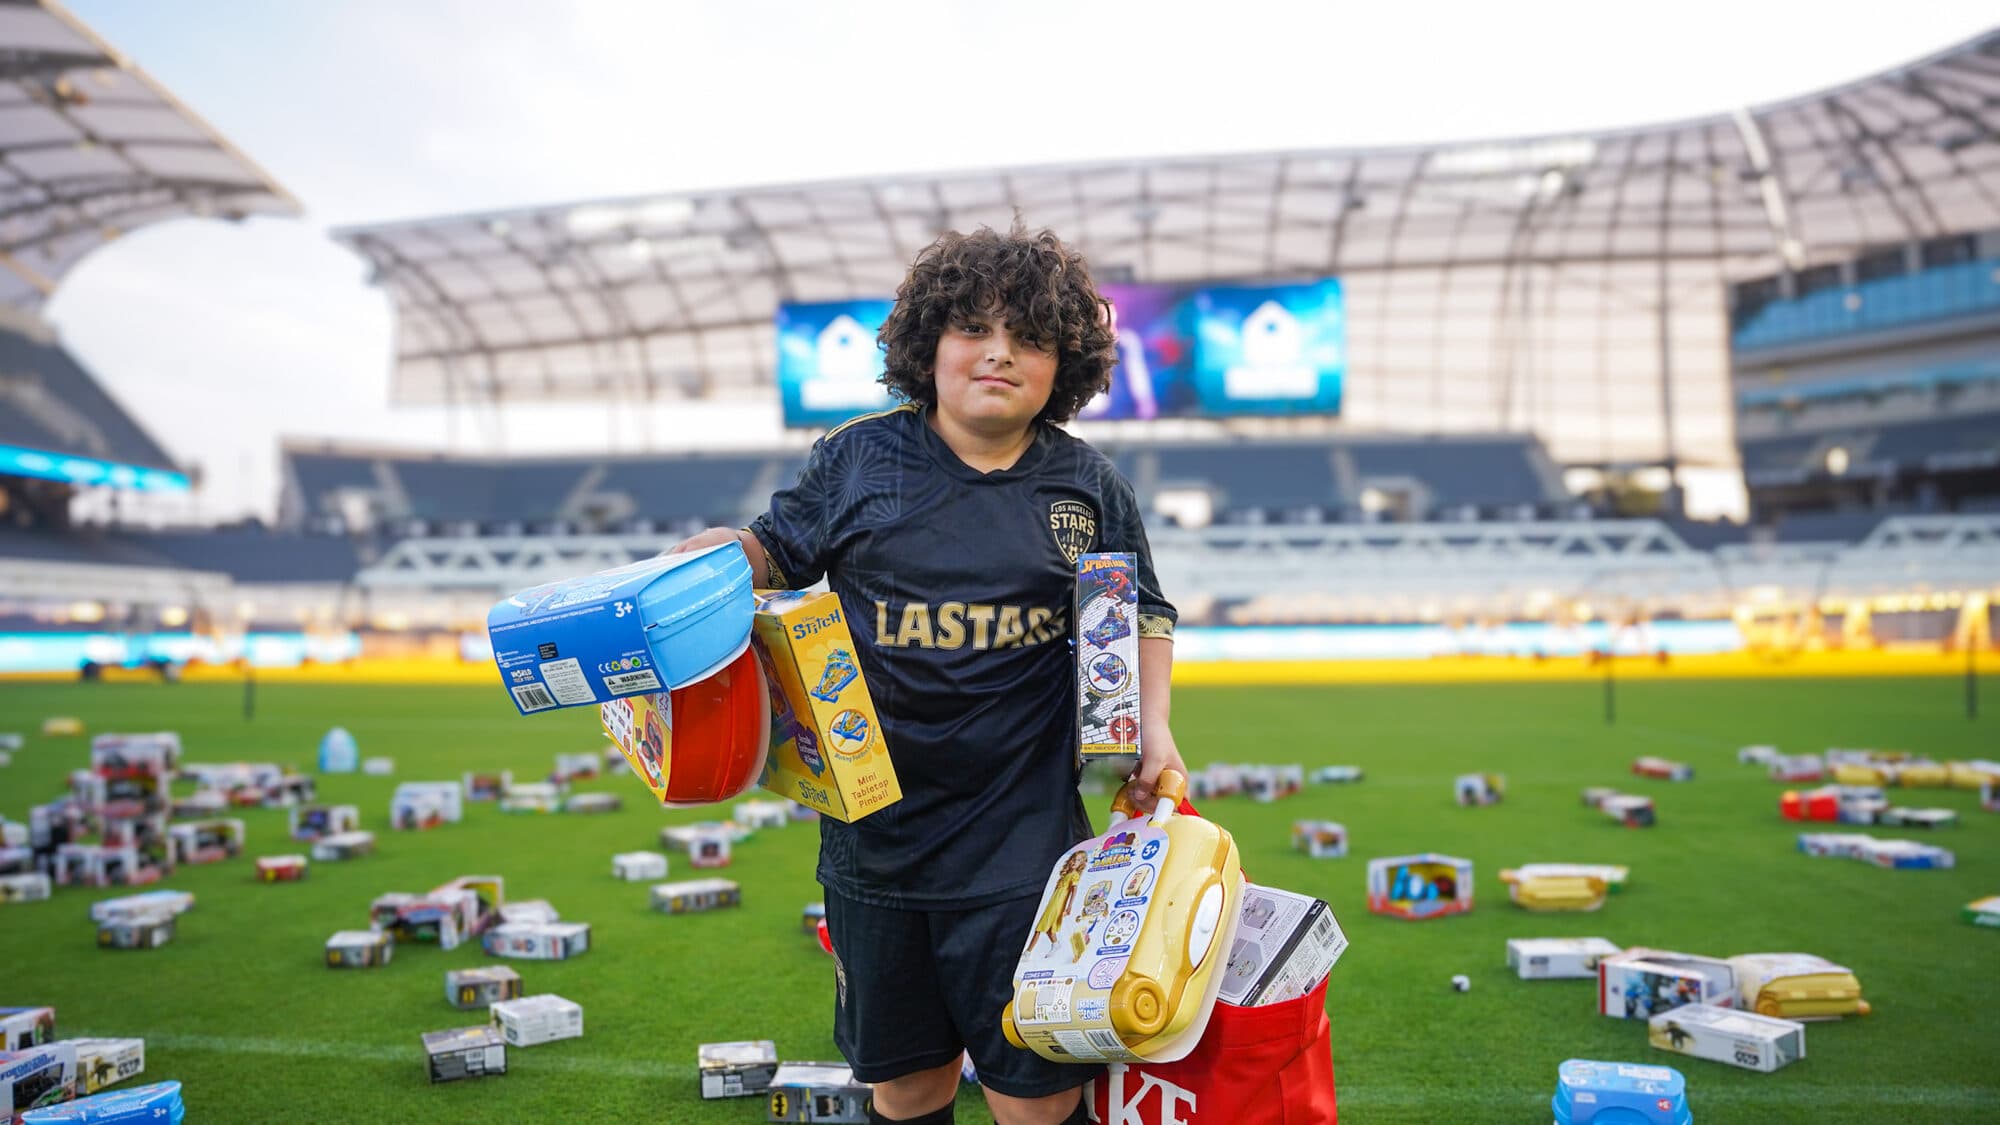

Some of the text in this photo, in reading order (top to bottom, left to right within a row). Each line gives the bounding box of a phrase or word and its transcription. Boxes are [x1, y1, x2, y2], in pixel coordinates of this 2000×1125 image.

[1055, 505, 1092, 519] LOS ANGELES
[1050, 513, 1095, 537] STARS
[613, 601, 634, 618] 3+
[851, 779, 889, 800] Tabletop
[858, 790, 889, 809] Pinball
[1143, 845, 1157, 857] 3+
